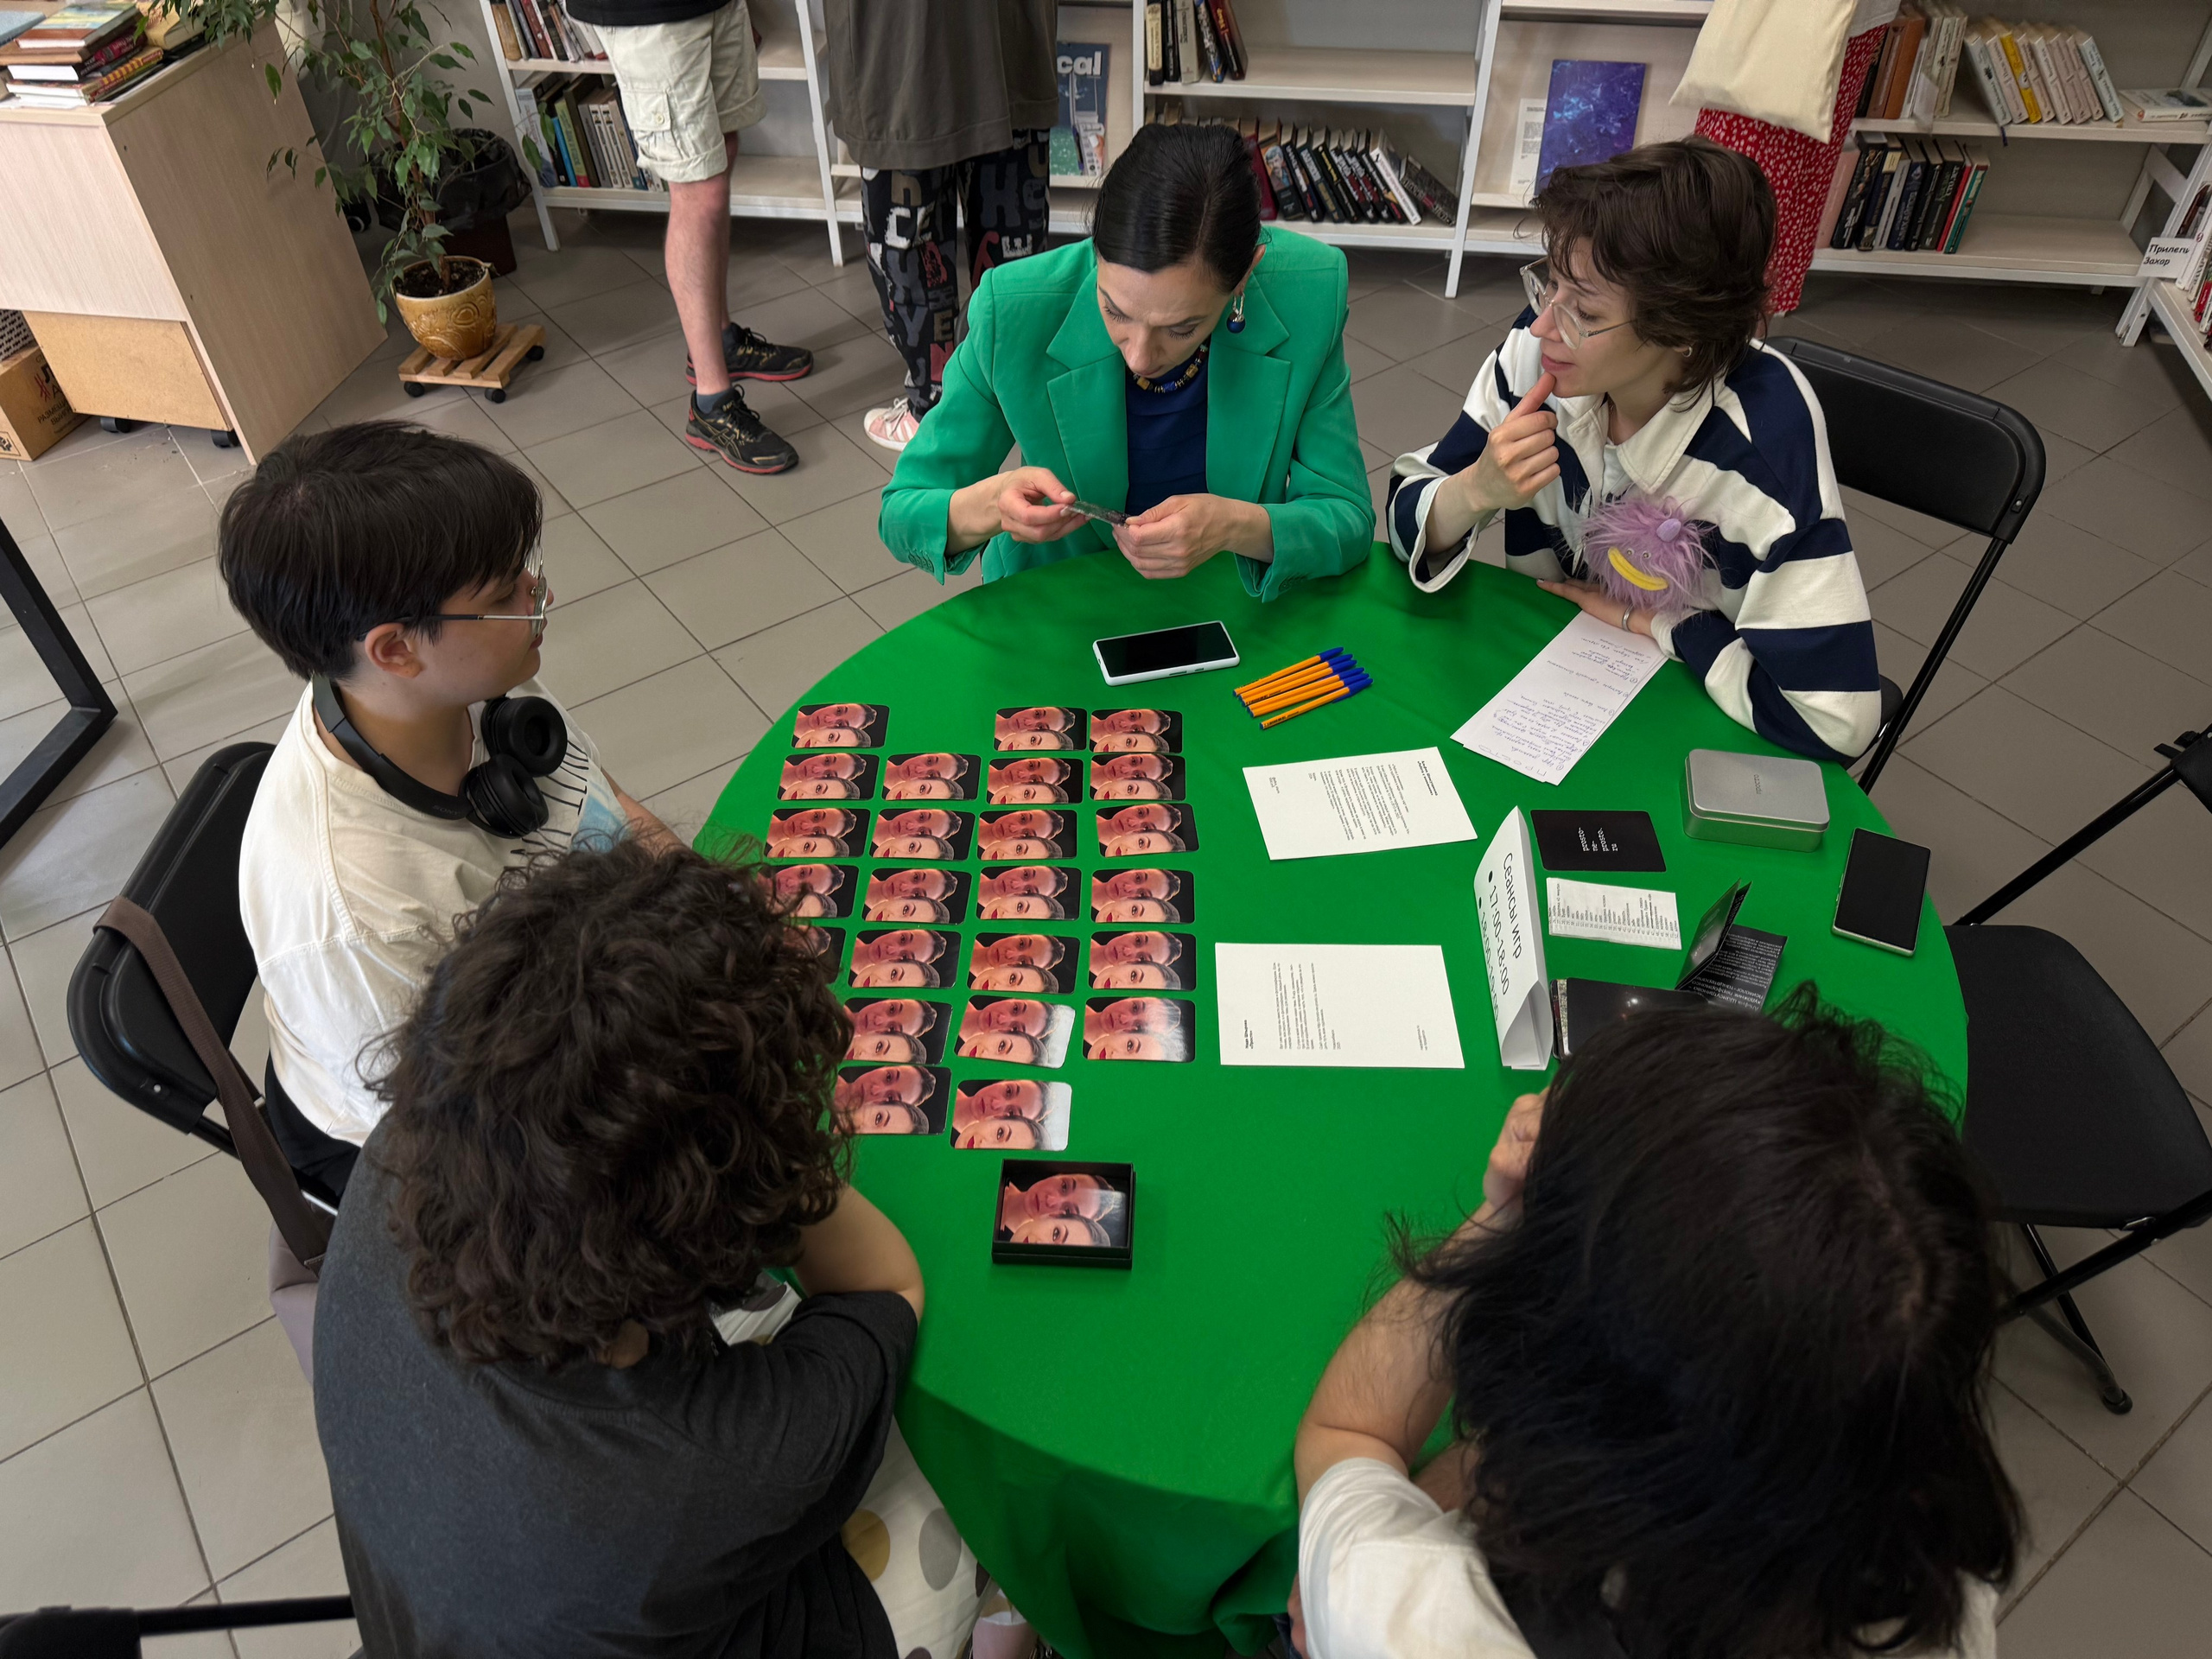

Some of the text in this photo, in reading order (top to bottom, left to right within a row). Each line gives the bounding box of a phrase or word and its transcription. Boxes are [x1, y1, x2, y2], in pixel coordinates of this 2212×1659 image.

[1490, 885, 1510, 995] 17:00-18:00
[1503, 852, 1522, 959] Сеансы игр
